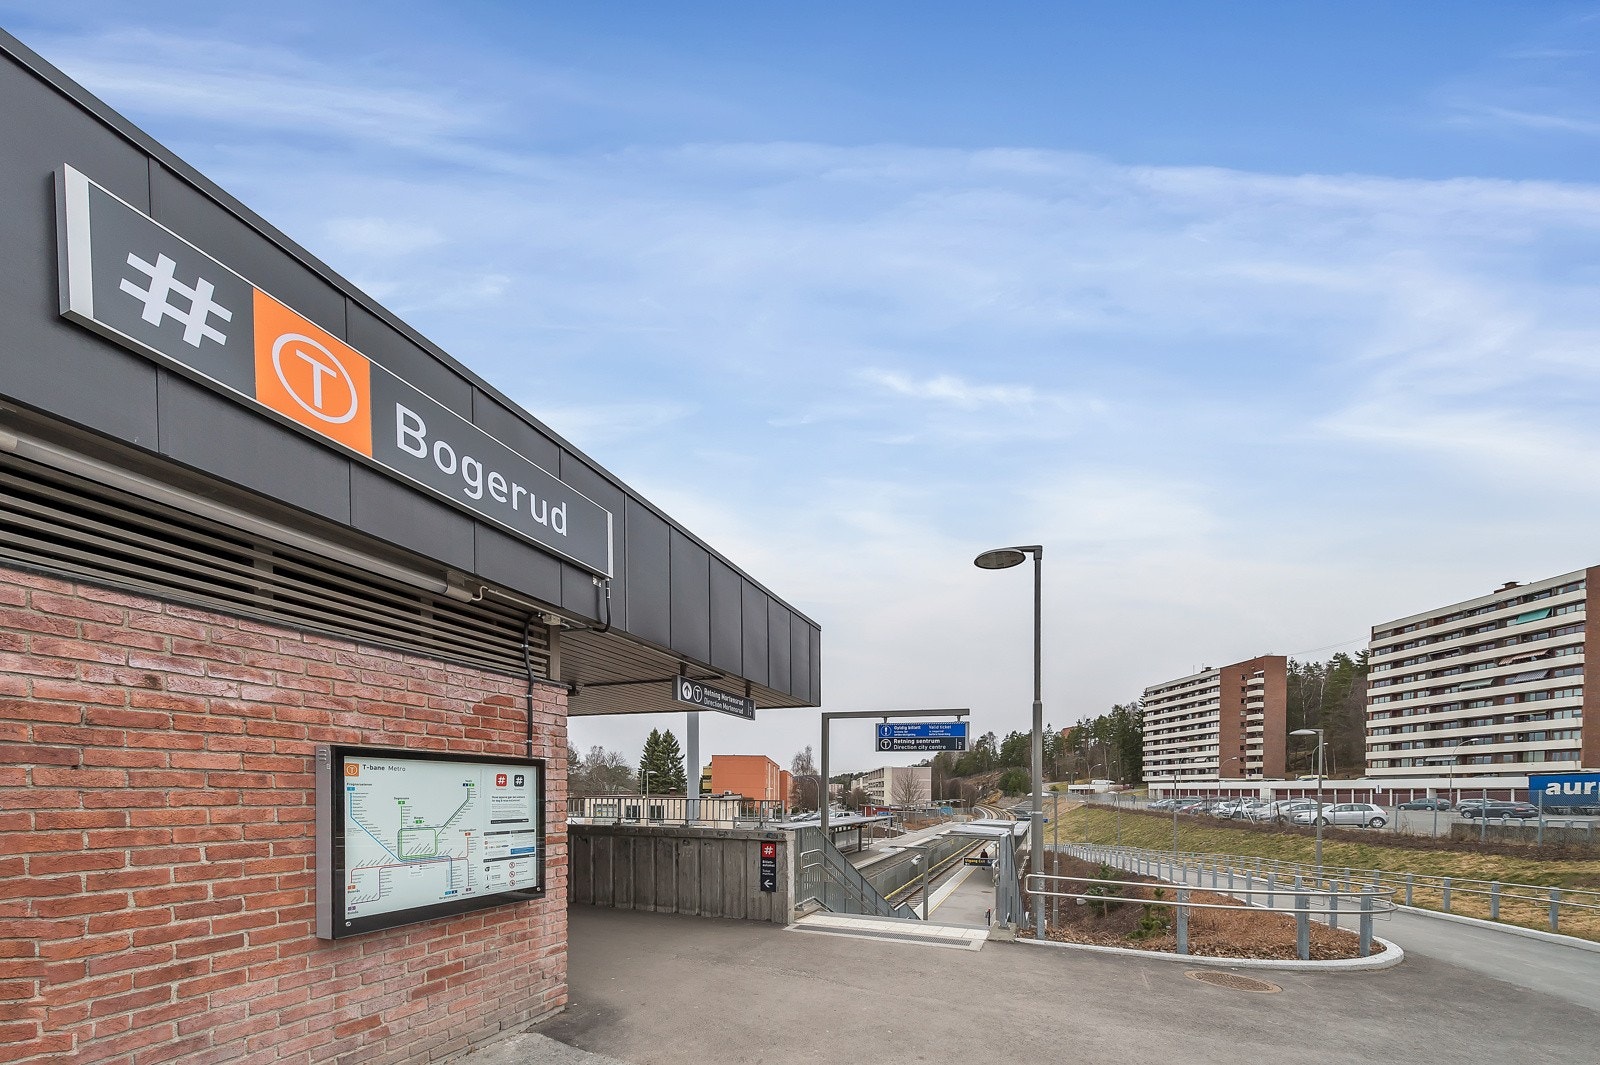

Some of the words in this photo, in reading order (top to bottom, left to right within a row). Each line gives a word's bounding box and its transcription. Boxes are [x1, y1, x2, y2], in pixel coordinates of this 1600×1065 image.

[395, 402, 567, 536] Bogerud
[704, 688, 720, 700] Retning
[704, 697, 722, 708] Direction
